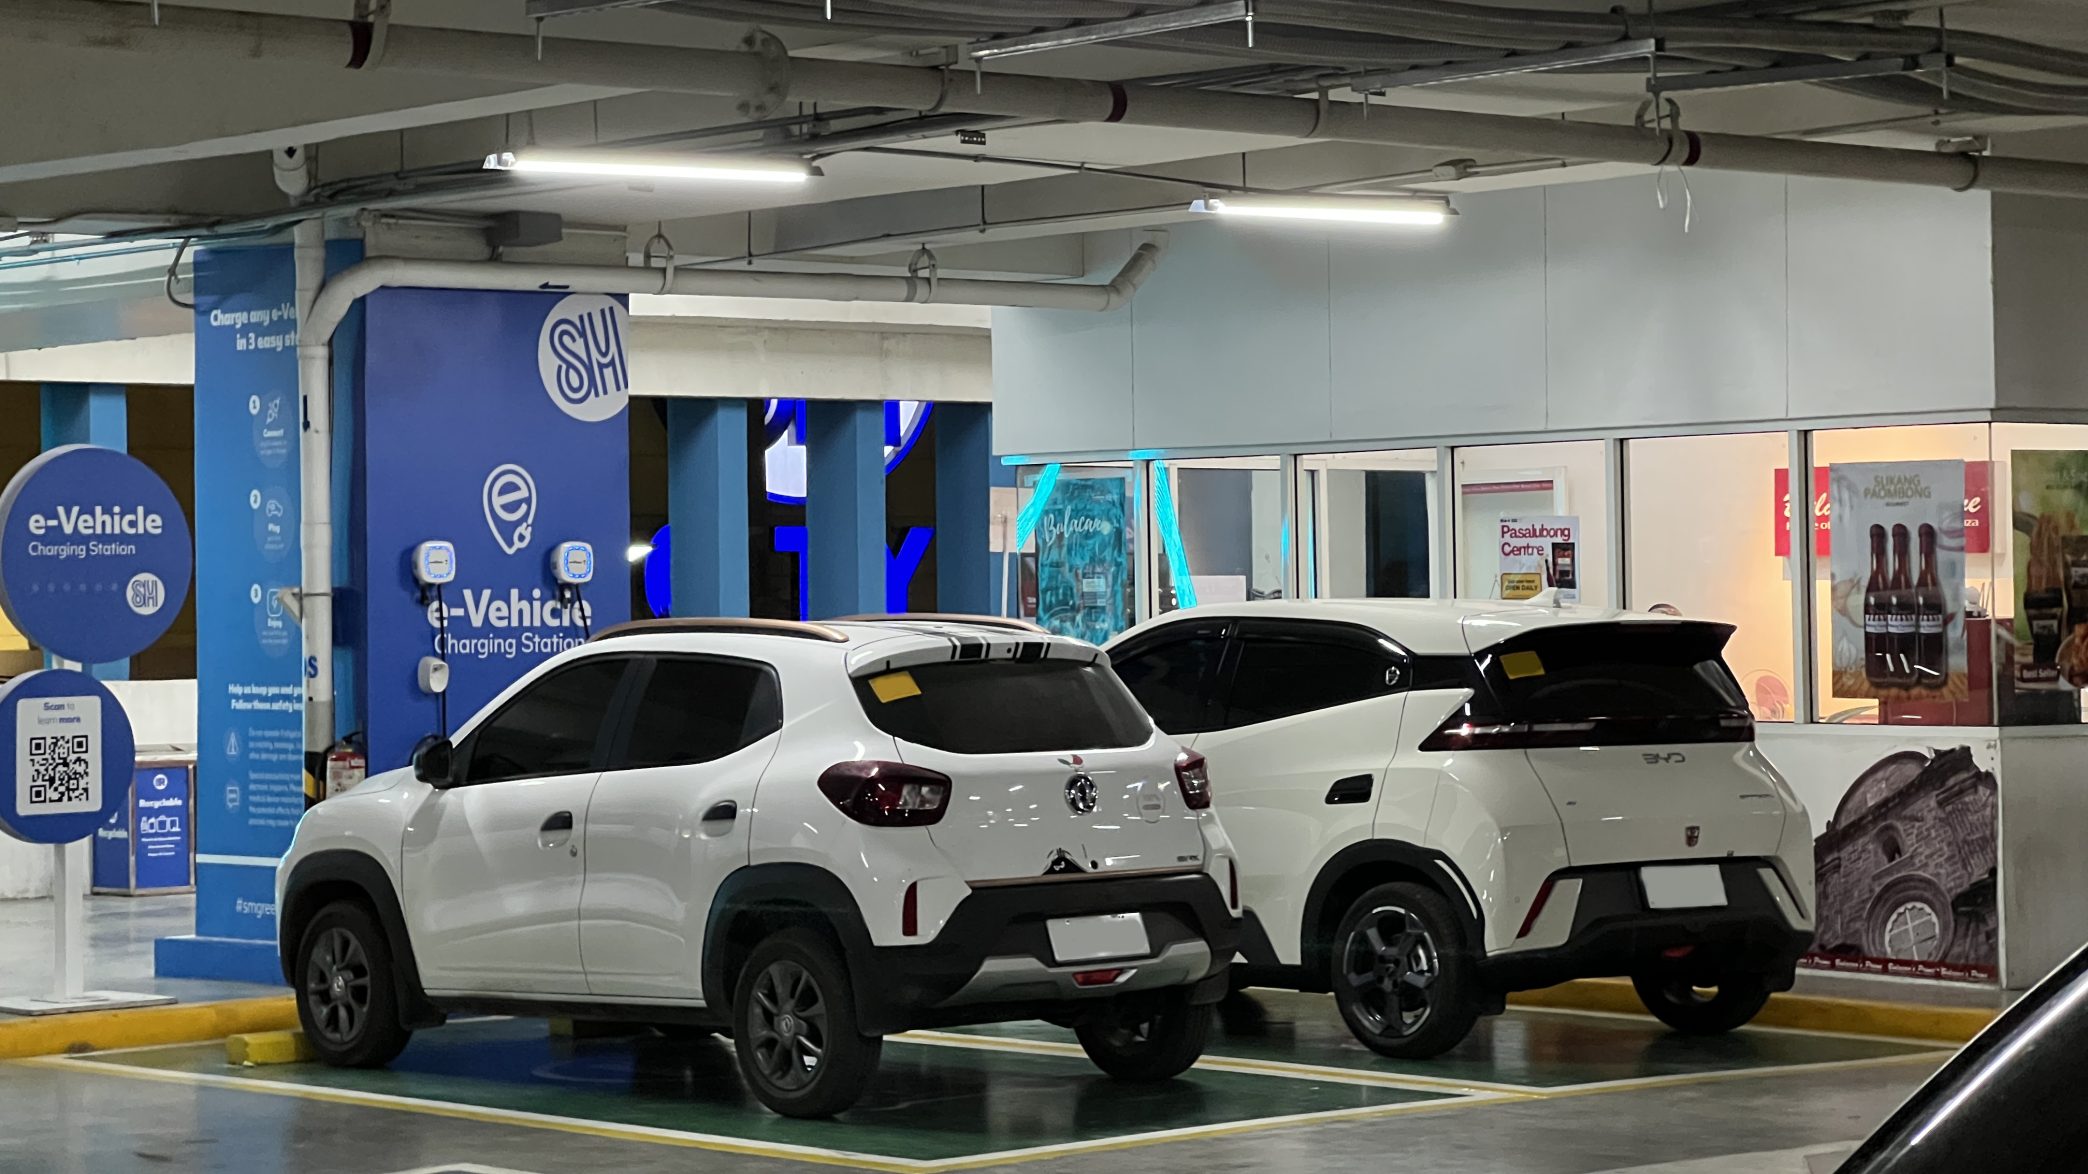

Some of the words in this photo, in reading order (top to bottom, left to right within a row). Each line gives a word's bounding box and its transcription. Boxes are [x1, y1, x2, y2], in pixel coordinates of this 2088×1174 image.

[210, 309, 248, 329] Charge
[249, 309, 270, 326] any
[271, 302, 298, 321] e-Ve
[236, 333, 247, 351] in
[248, 332, 256, 350] 3
[257, 334, 284, 352] easy
[1873, 474, 1921, 488] SUKANG
[1863, 486, 1932, 499] PAOMBONG
[28, 505, 163, 535] e-Vehicle
[1501, 523, 1571, 542] Pasalubong
[28, 541, 86, 559] Charging
[89, 541, 136, 556] Station
[1501, 541, 1544, 557] Centre
[427, 588, 592, 628] e-Vehicle
[434, 632, 516, 658] Charging
[43, 702, 65, 711] Scan
[59, 715, 81, 724] more
[1641, 752, 1686, 764] BYD
[235, 897, 276, 918] #smgree
